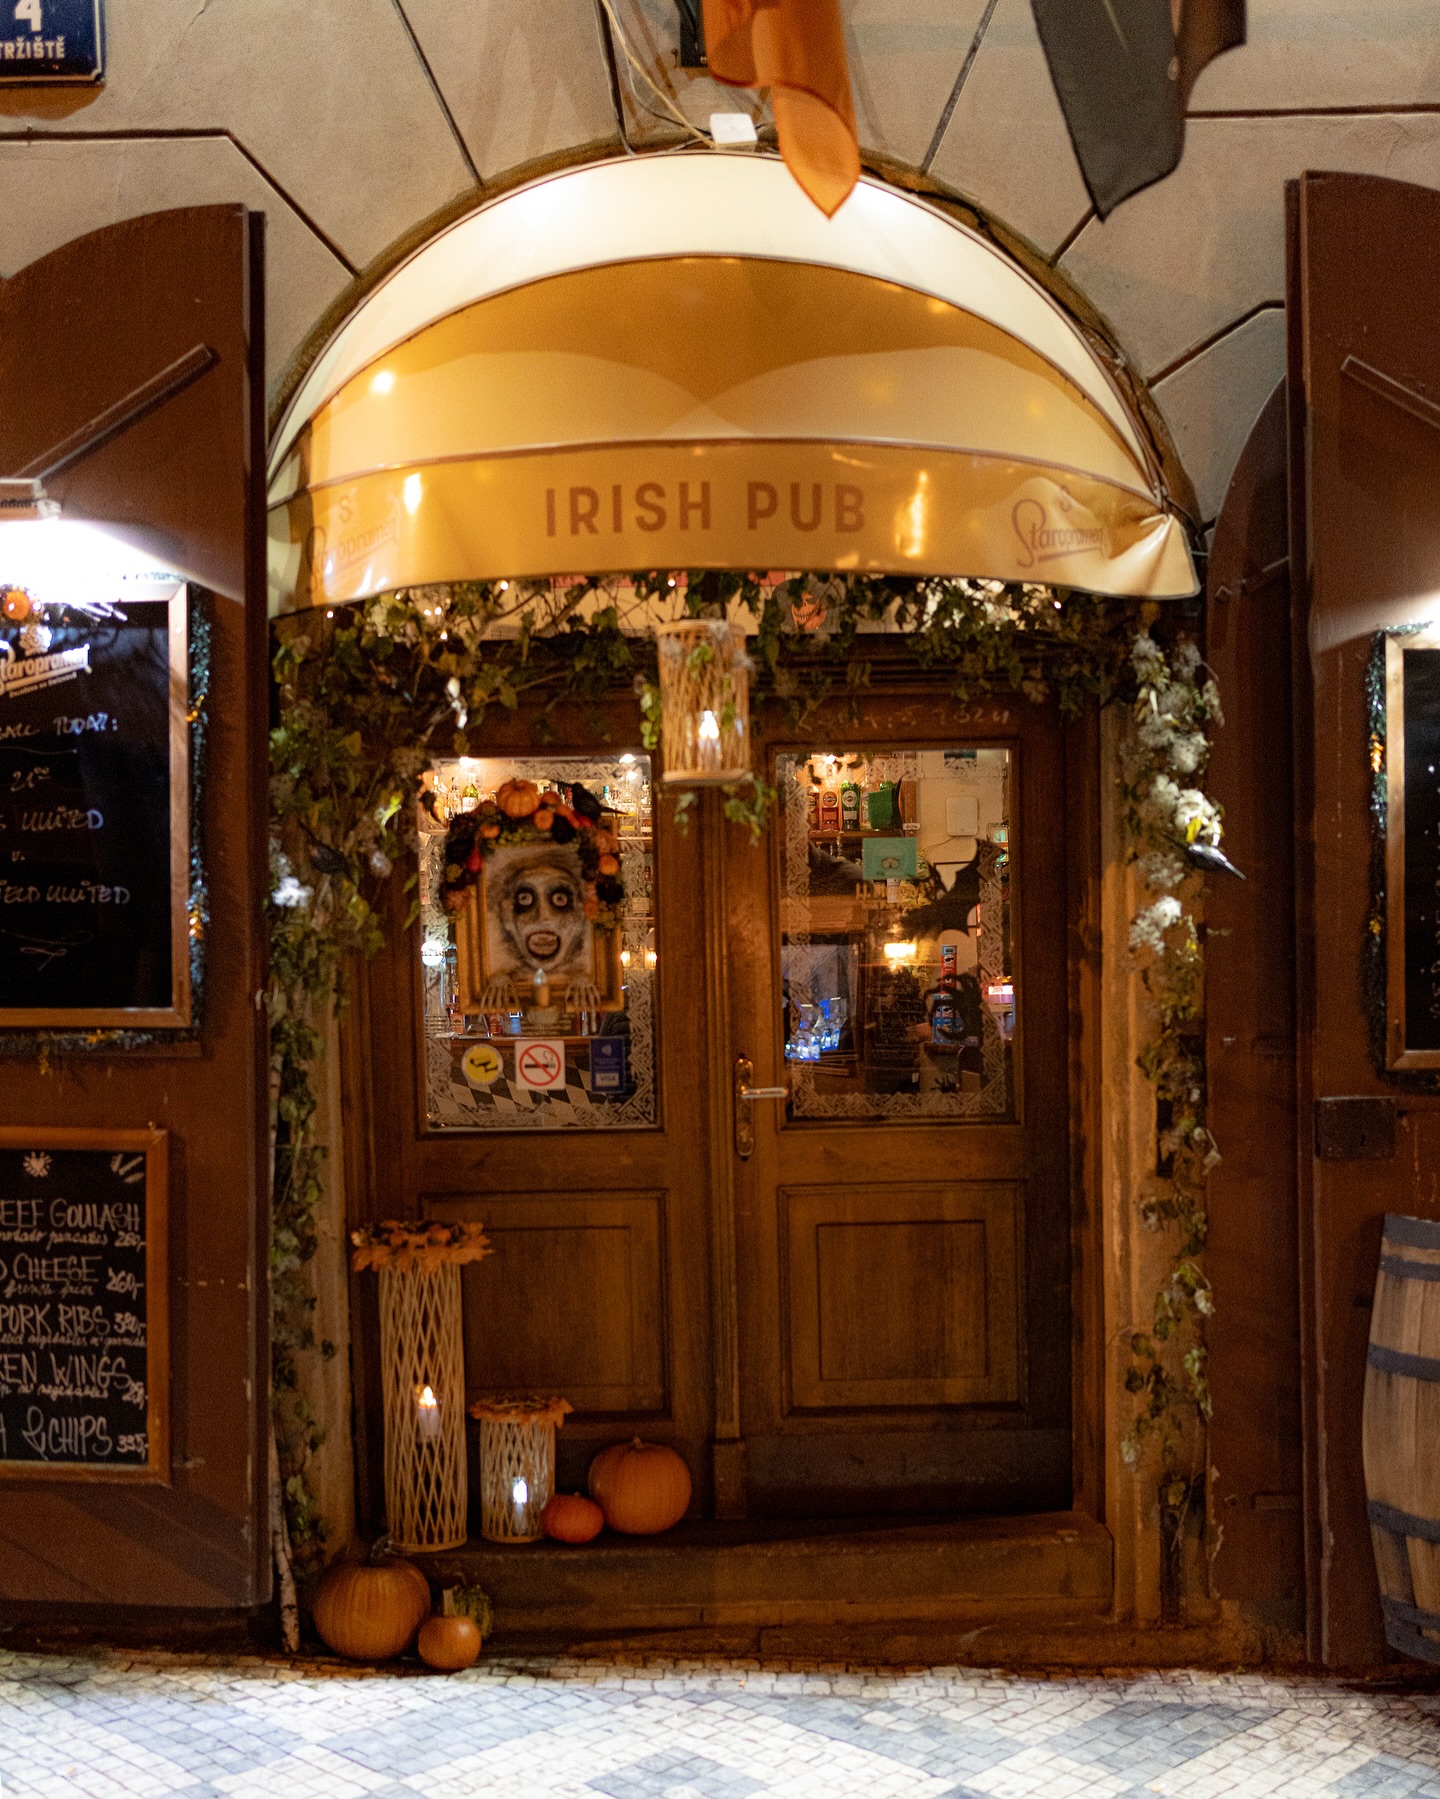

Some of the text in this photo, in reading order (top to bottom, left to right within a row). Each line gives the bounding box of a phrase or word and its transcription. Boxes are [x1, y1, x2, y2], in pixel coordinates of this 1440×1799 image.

[545, 480, 866, 538] IRISH PUB
[21, 804, 104, 832] UNITED
[46, 879, 131, 906] UNITED
[49, 1198, 139, 1232] GOULASH
[13, 1252, 103, 1283] CHEESE
[0, 1302, 53, 1337] PORK
[58, 1303, 111, 1337] RIBS
[49, 1351, 133, 1390] WINGS
